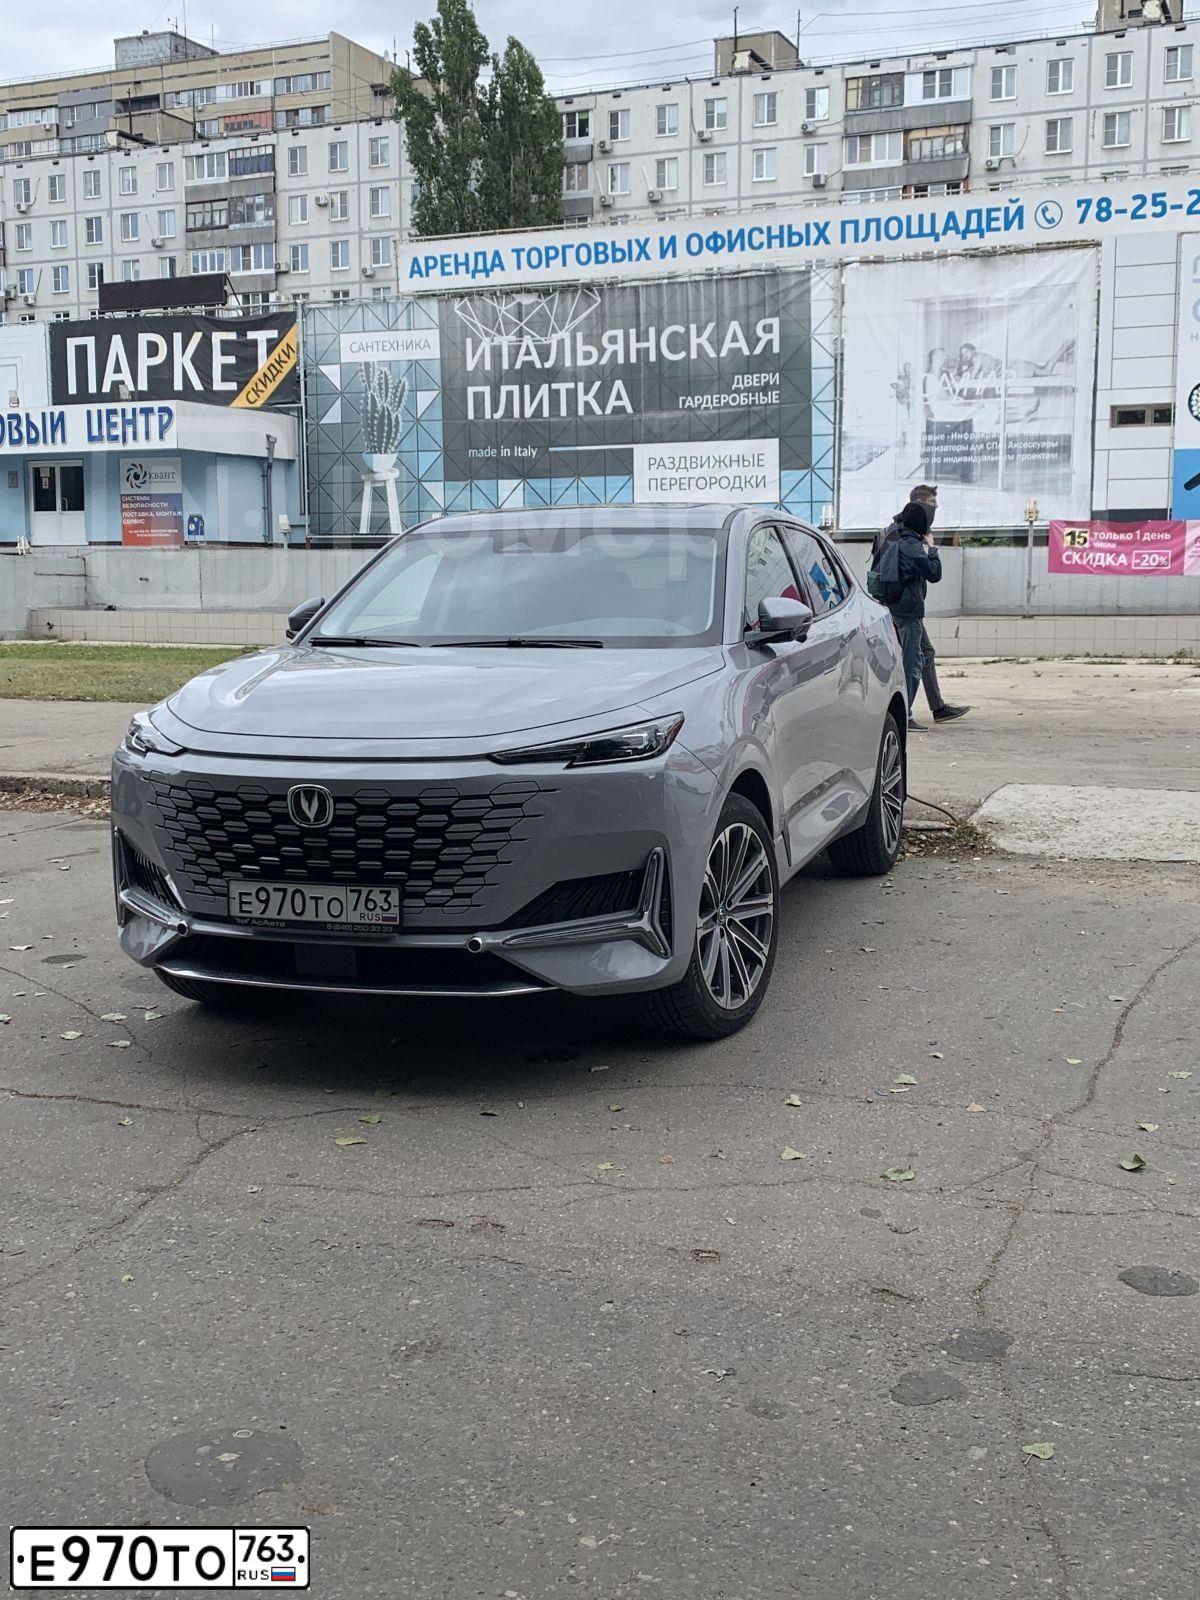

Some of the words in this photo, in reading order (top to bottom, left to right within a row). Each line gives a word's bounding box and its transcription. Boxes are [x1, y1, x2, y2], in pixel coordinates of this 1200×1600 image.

[408, 250, 505, 279] АРЕНДА
[511, 237, 652, 271] ТОРГОВЫХ
[659, 235, 677, 259] И
[685, 219, 831, 256] ОФИСНЫХ
[840, 198, 1024, 244] ПЛОЩАДЕЙ
[1076, 189, 1200, 224] 78-25-2
[349, 338, 431, 354] САНТЕХНИКА
[465, 316, 780, 372] ИТАЛЬЯНСКАЯ
[66, 329, 278, 395] ПАРКЕТ
[245, 342, 296, 405] СКИДКИ
[732, 372, 780, 390] ДВЕРИ
[467, 380, 634, 420] ПЛИТКА
[678, 390, 780, 410] ГАРДЕРОБНЫЕ
[86, 405, 174, 447] ЦЕНТР
[468, 445, 497, 458] made
[501, 445, 511, 457] in
[514, 444, 538, 458] Italy
[1007, 439, 1059, 451] Аксессуары
[648, 452, 766, 473] РАЗДВИЖНЫЕ
[943, 453, 1014, 464] индивидуальнм
[1016, 452, 1058, 462] проектам
[648, 474, 767, 492] ПЕРЕГОРОДКИ
[1065, 530, 1088, 546] 15
[1093, 531, 1133, 541] только
[1135, 530, 1140, 540] 1
[1143, 531, 1171, 541] день
[1062, 551, 1127, 567] СКИДКА
[1134, 553, 1169, 567] -20%
[238, 886, 344, 919] Е970ТО
[350, 888, 392, 912] 763
[359, 912, 381, 921] RUS
